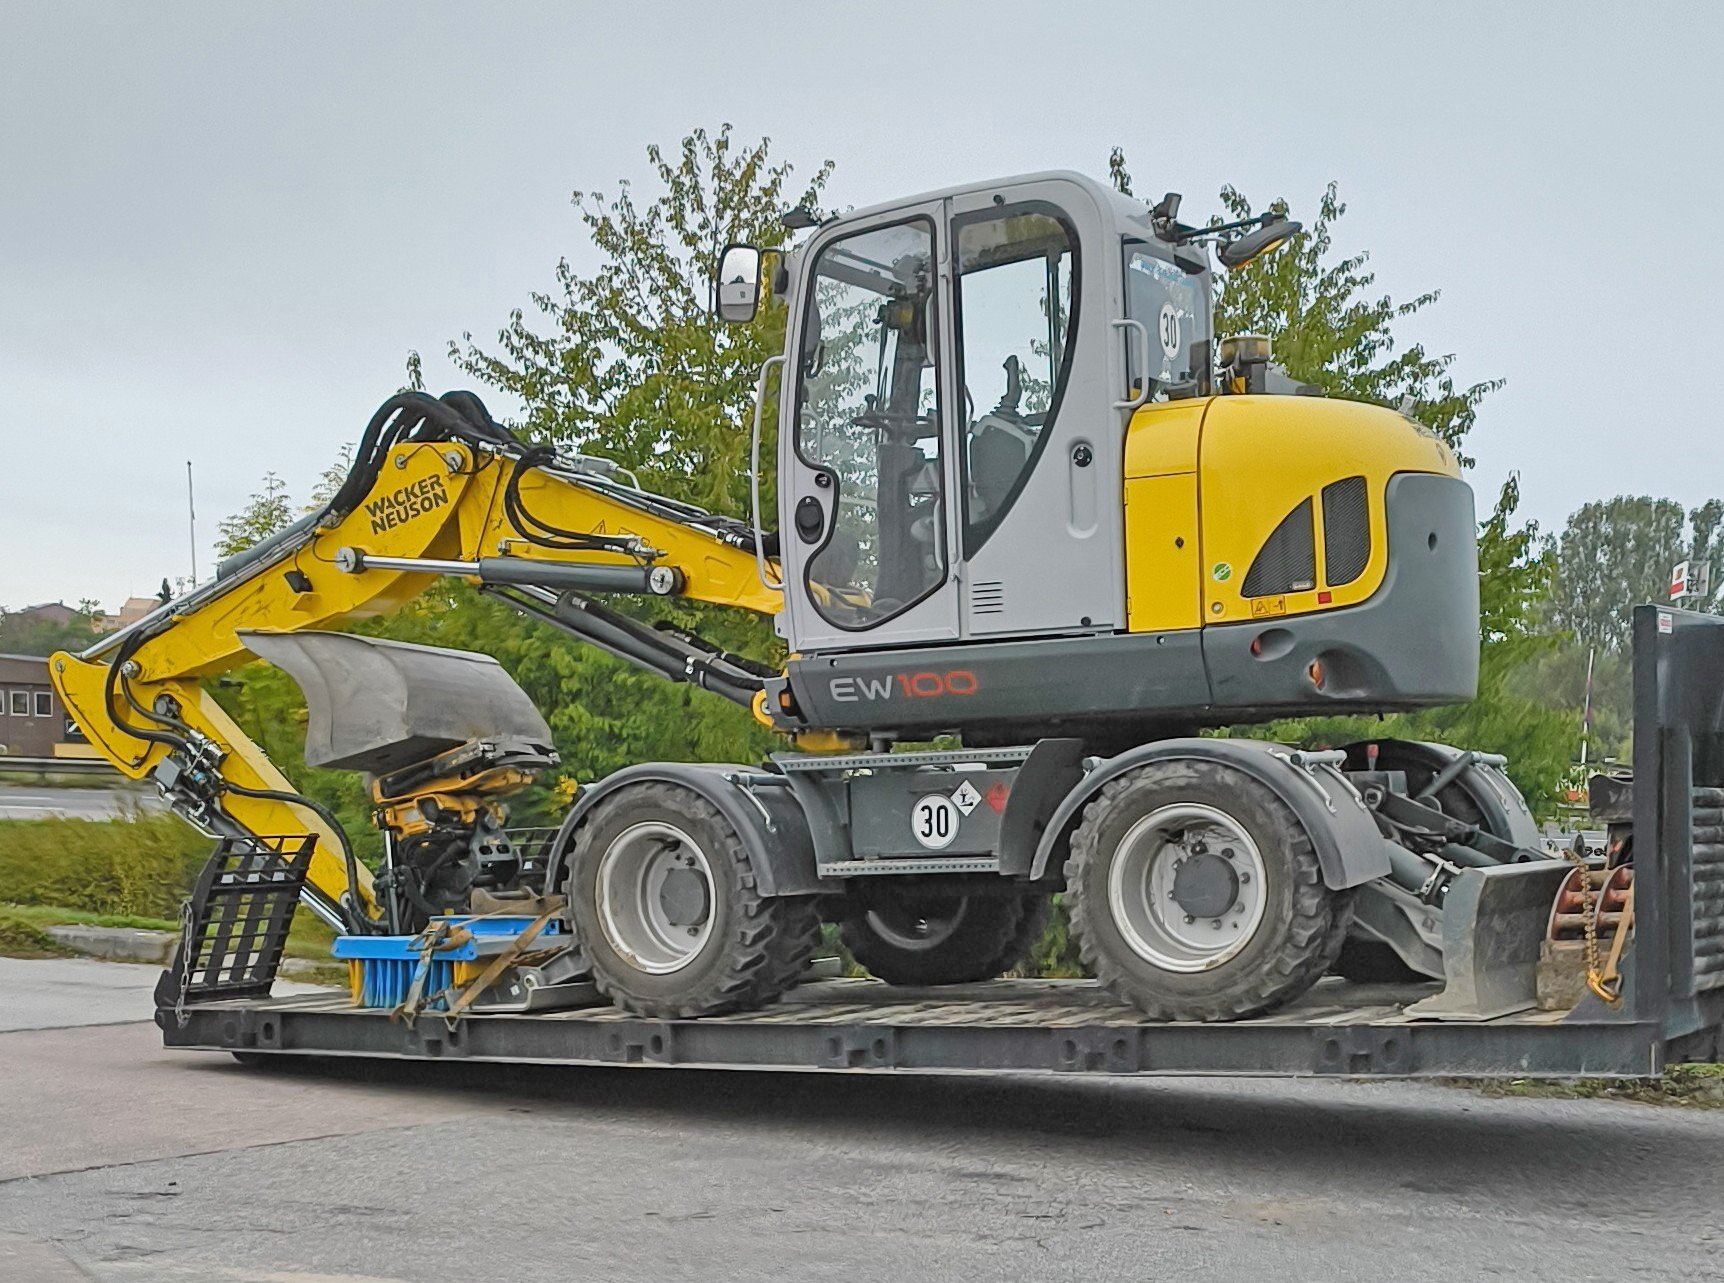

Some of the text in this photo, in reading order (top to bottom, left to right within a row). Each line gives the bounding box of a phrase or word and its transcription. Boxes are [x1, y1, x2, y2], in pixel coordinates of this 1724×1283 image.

[1163, 313, 1177, 349] 30
[364, 473, 444, 518] WACKER
[370, 488, 449, 535] NEUSON
[920, 804, 949, 838] 30
